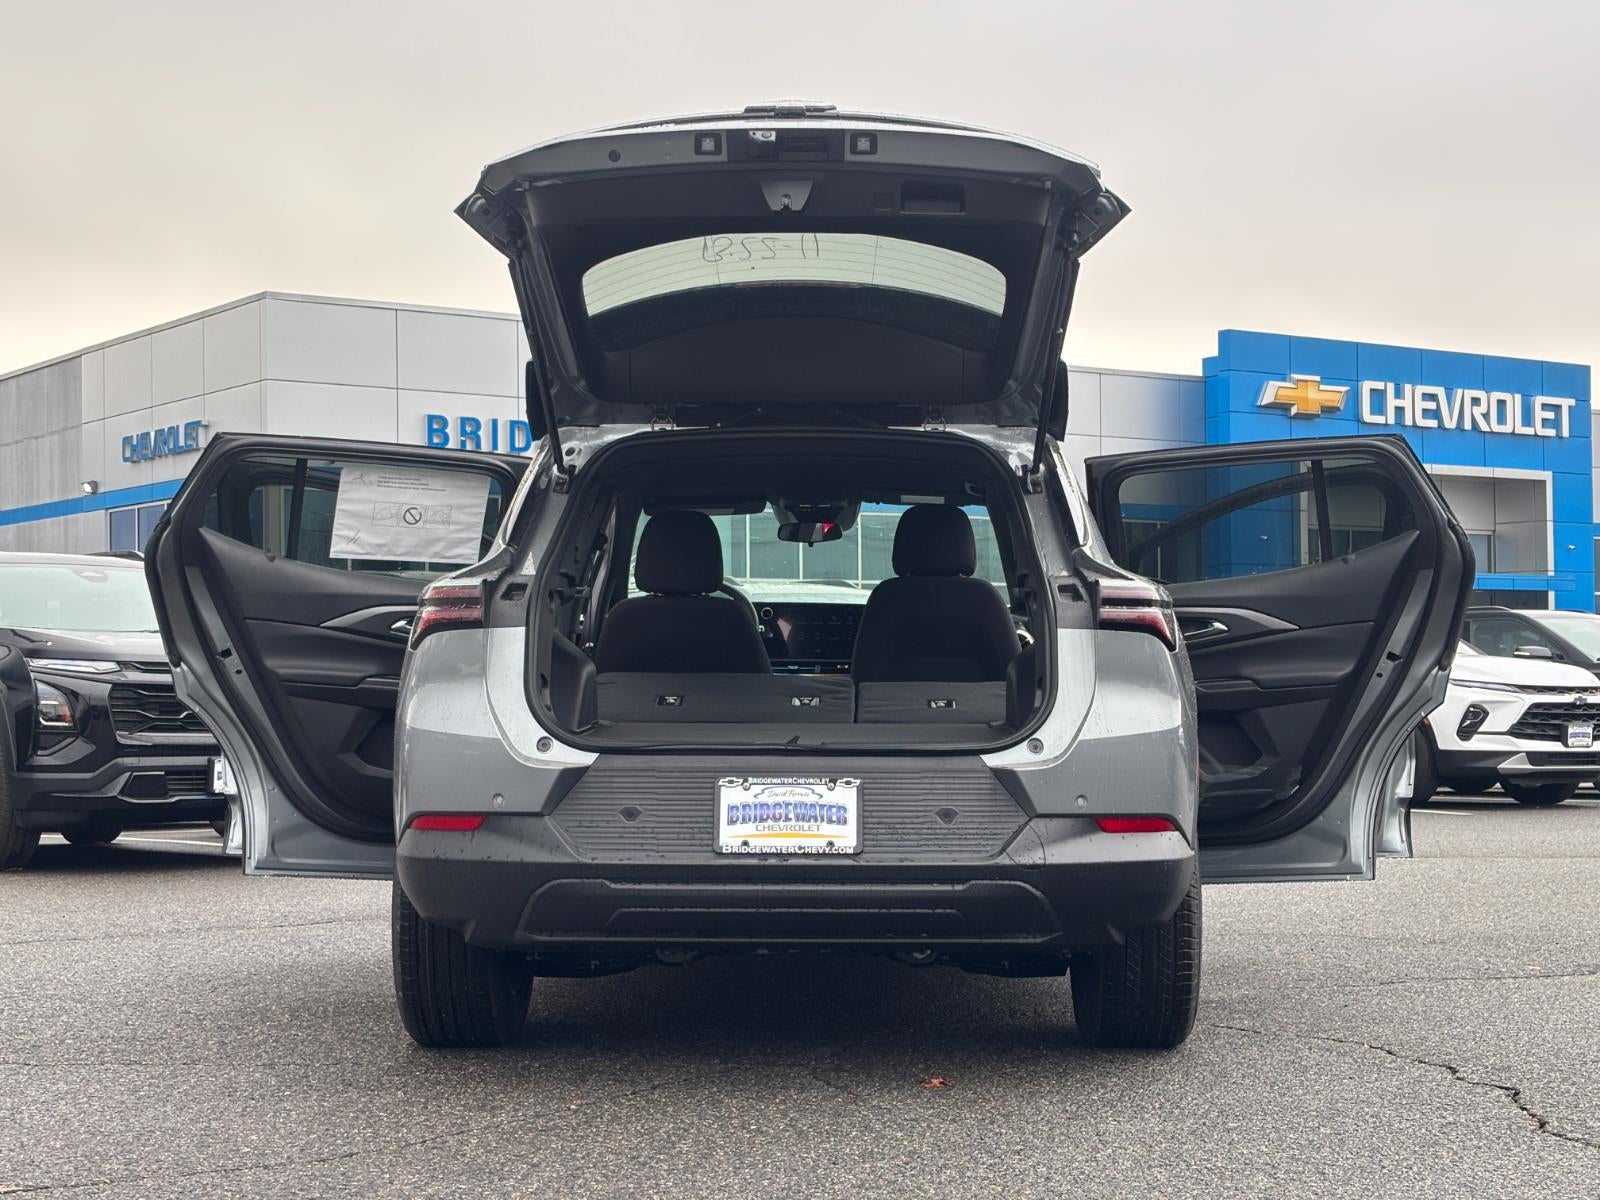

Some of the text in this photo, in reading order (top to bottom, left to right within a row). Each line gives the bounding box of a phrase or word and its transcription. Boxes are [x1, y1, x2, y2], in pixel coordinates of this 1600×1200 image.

[1360, 380, 1575, 438] CHEVROLET
[122, 419, 208, 463] CHEVROLET
[425, 413, 533, 453] BRID
[748, 777, 830, 785] BRIDGEWATERCHEVROLET
[727, 800, 848, 826] BRIDGEWATER
[755, 824, 821, 832] CHEVROLET
[722, 844, 854, 854] BRIDGEWATERCHEVY.COM
